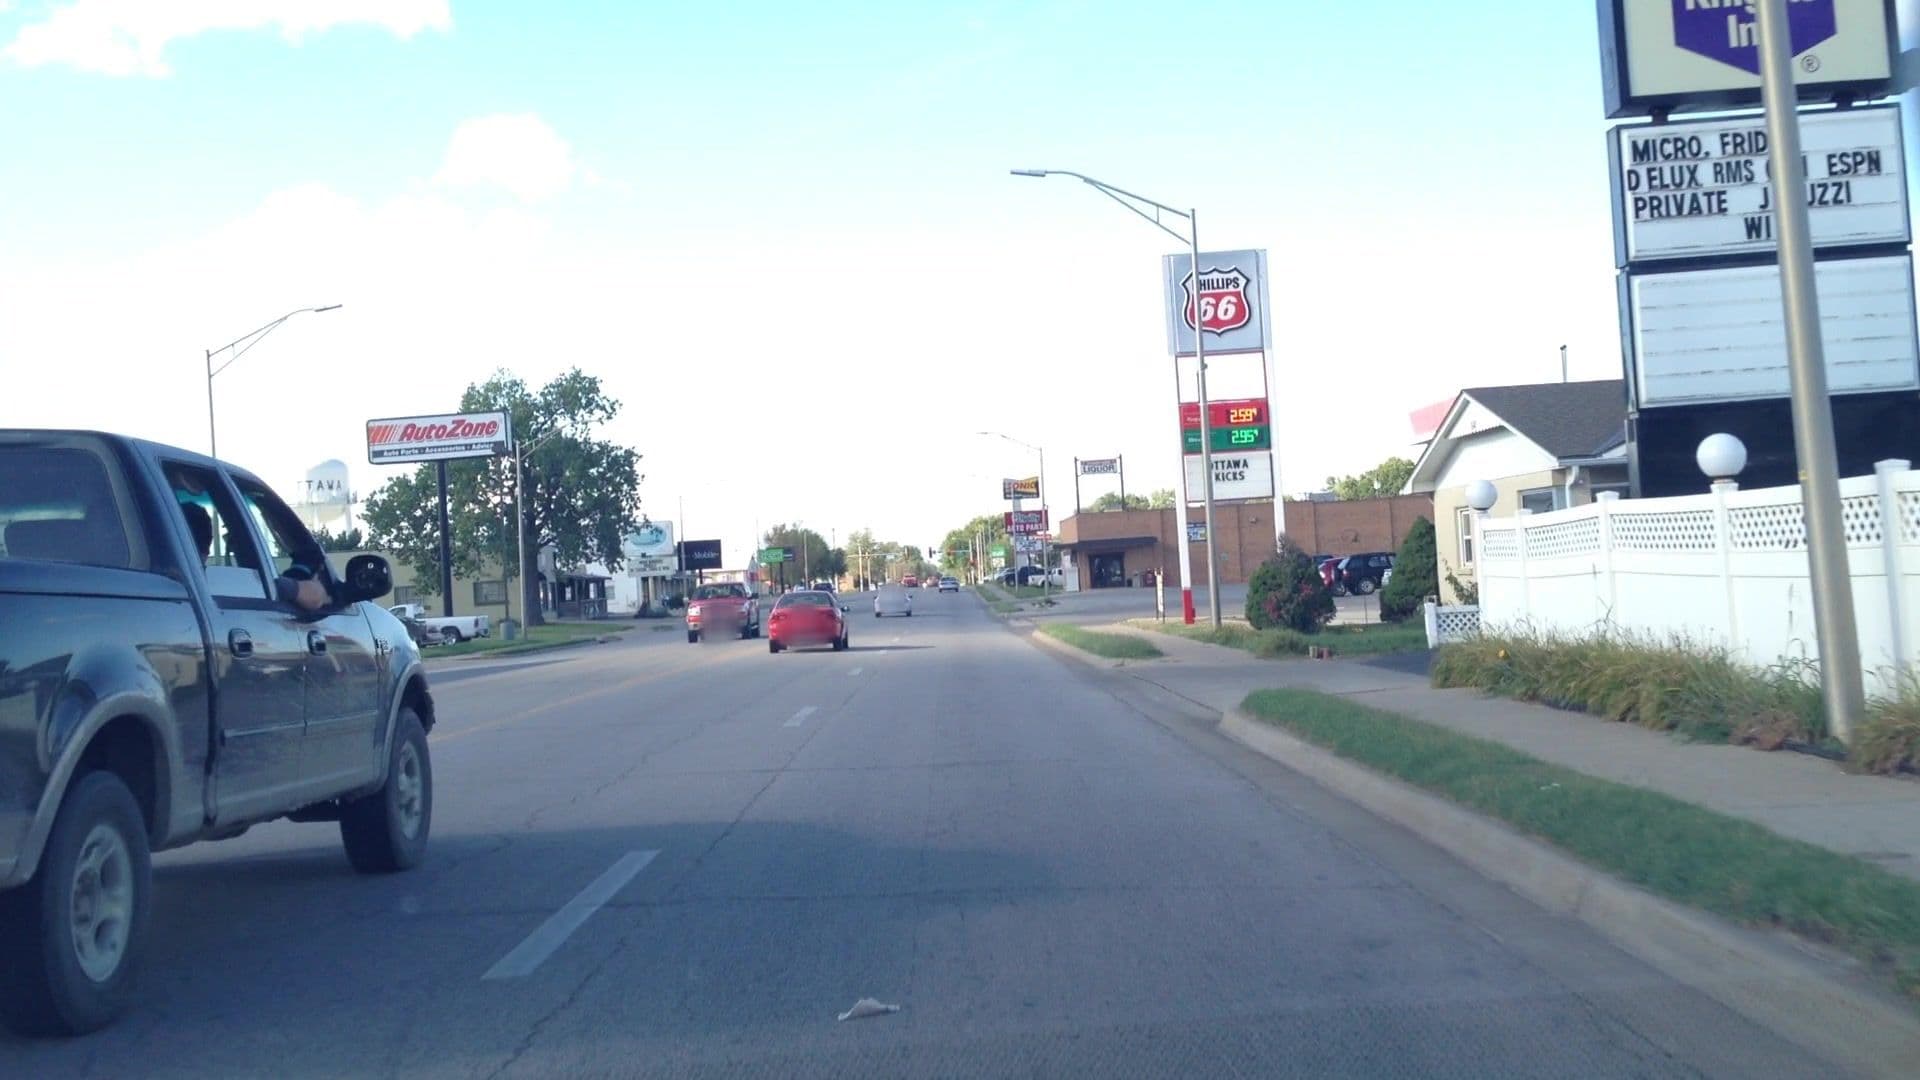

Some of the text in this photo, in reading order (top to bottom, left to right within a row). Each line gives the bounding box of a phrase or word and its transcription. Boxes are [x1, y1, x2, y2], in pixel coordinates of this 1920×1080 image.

[1727, 14, 1760, 48] In
[1719, 131, 1768, 156] FRID
[1713, 159, 1755, 184] RMS
[1826, 149, 1882, 177] ESPN
[1633, 180, 1852, 219] PRIVATE JZZI
[1744, 215, 1772, 240] WI
[1199, 276, 1241, 292] HILLIPS
[1199, 295, 1238, 322] 66
[400, 419, 499, 442] AutoZone
[1083, 463, 1115, 473] LIQUOR
[1214, 471, 1245, 481] KICKS
